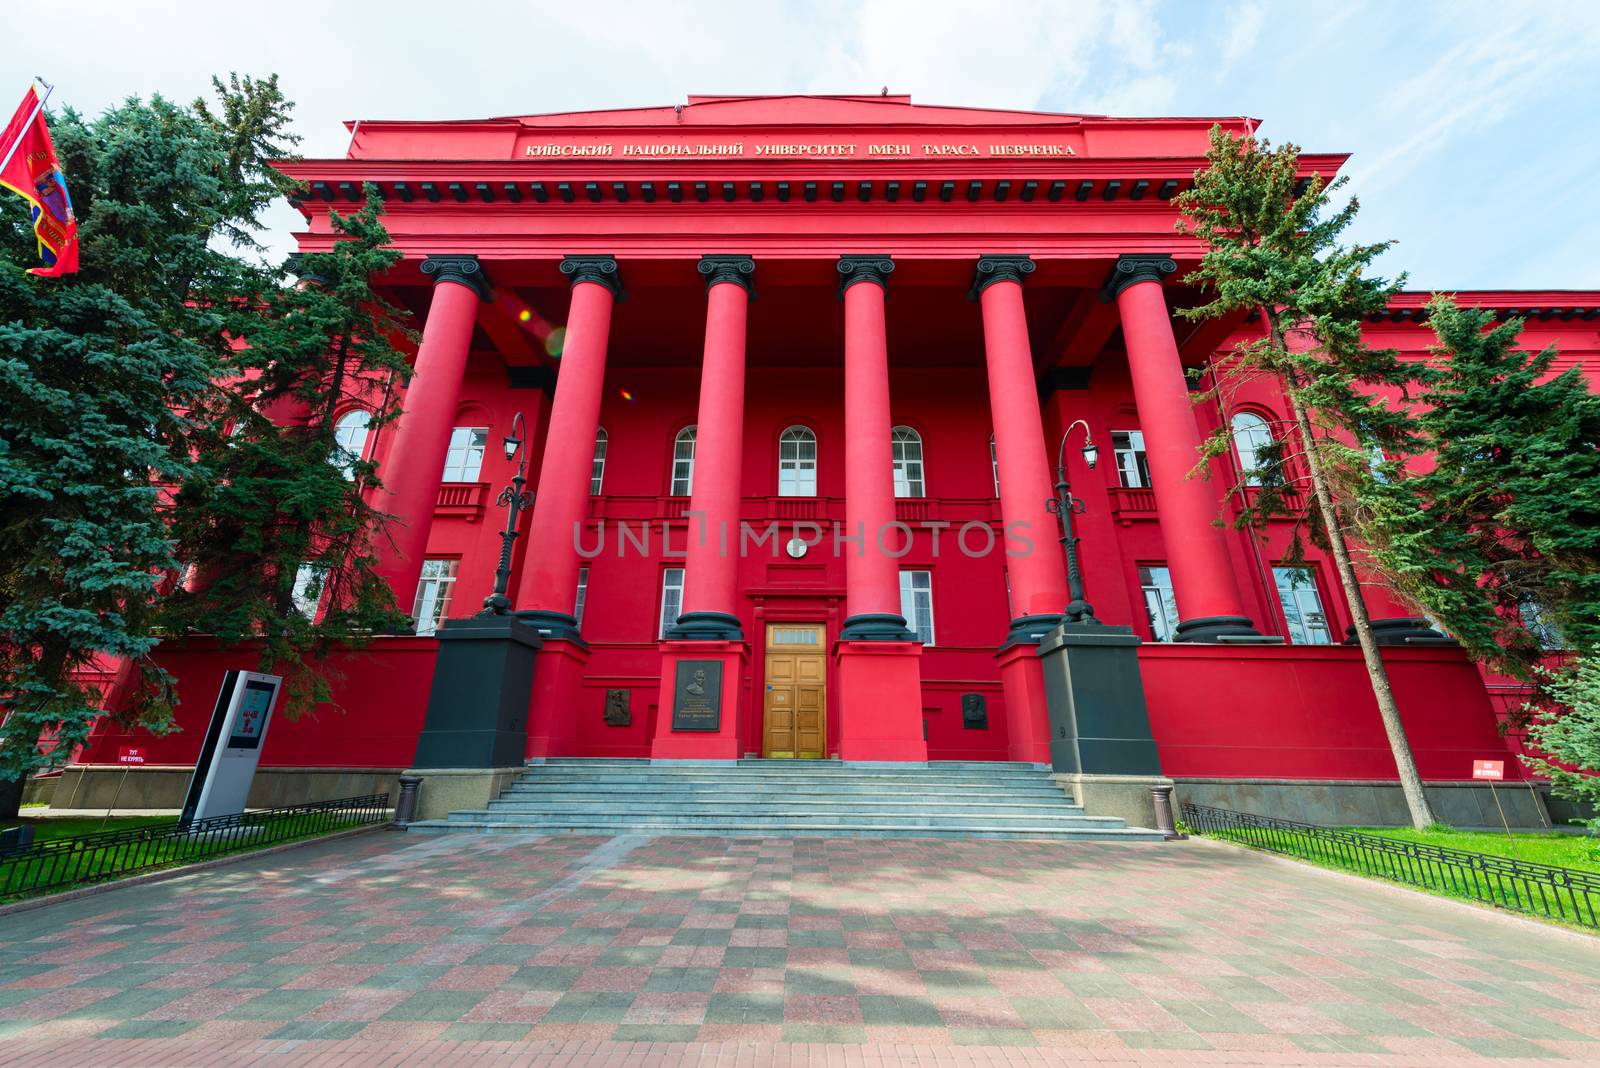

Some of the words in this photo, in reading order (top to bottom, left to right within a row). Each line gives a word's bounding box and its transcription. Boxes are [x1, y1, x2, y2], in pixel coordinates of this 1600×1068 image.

[526, 143, 613, 156] КИЇВСЬКИЙ
[623, 143, 744, 157] НАЦІОНАЛЬНИЙ
[755, 144, 857, 156] УНІВЕРСИТЕТ
[868, 144, 911, 156] ІМЕНІ
[922, 144, 980, 156] ТАРАСА
[989, 144, 1076, 156] ШЕВЧЕНКА
